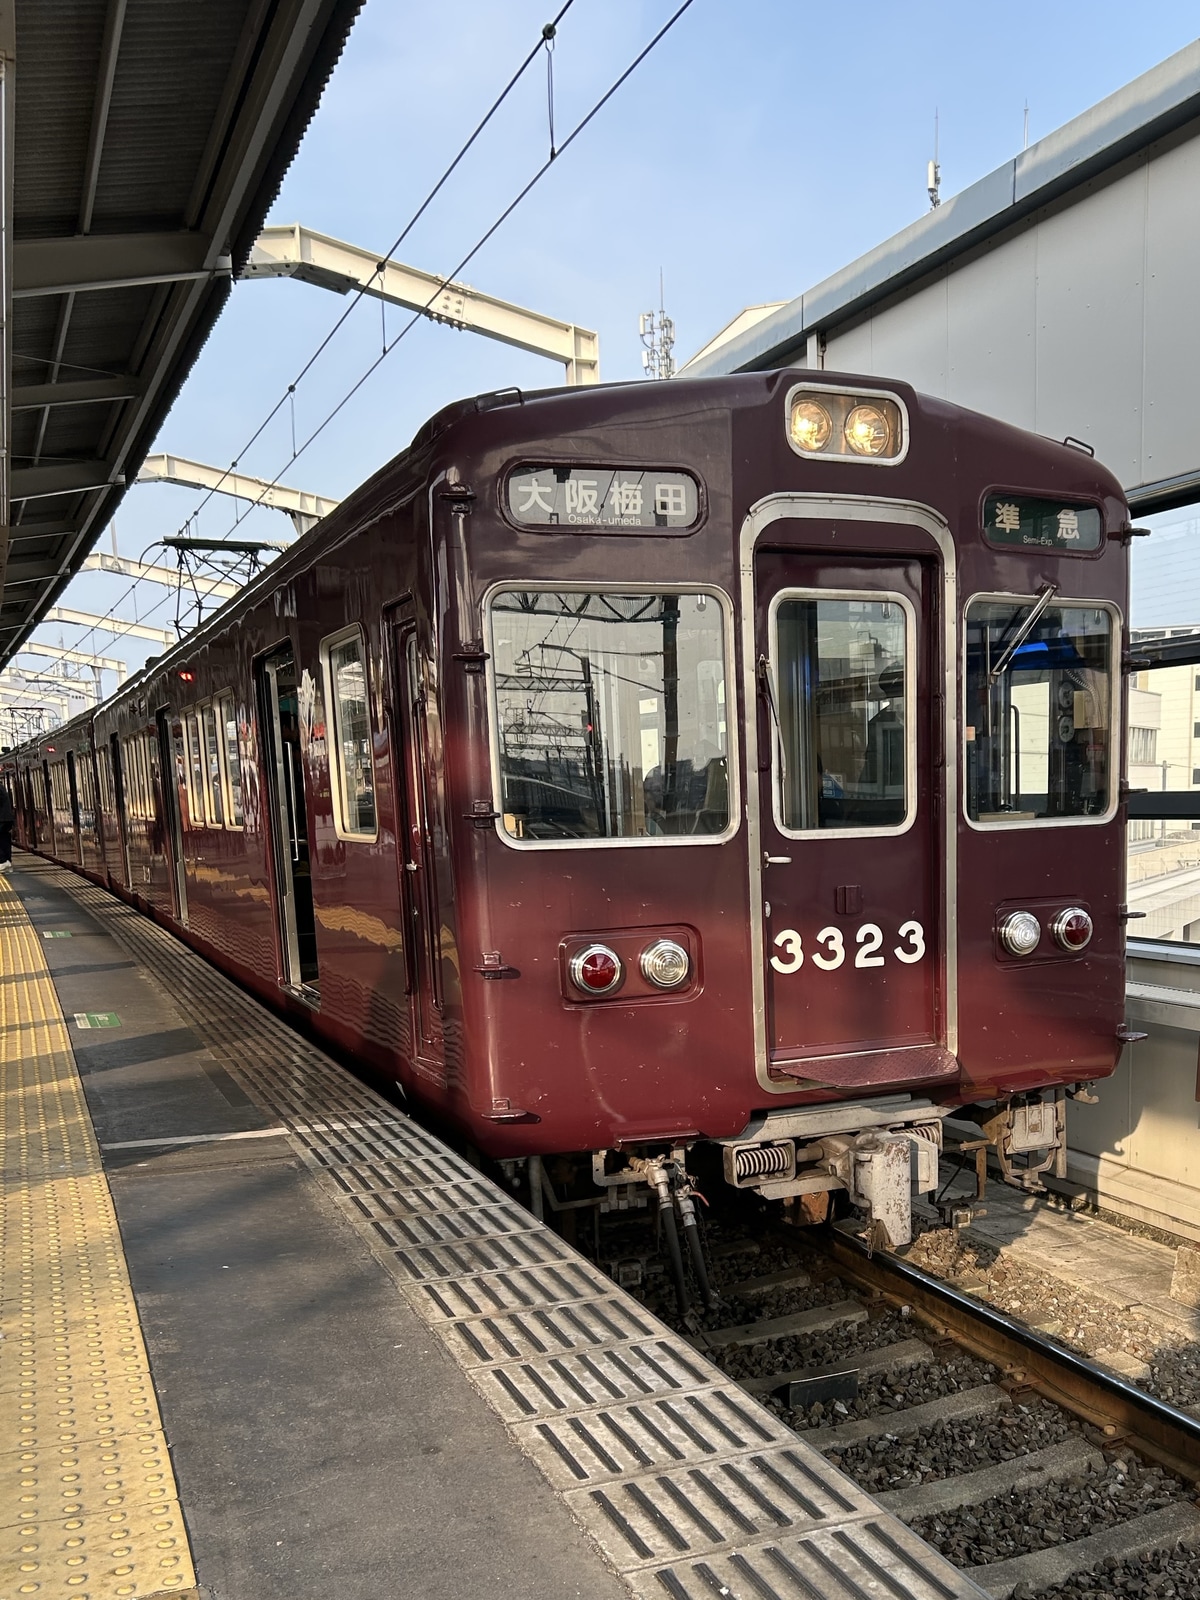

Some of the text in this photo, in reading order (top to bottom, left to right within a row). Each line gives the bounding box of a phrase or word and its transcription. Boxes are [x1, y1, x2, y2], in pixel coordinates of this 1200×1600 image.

[518, 478, 687, 516] 大阪梅田
[568, 514, 641, 526] Osaka-umeda
[995, 502, 1080, 540] 準急
[770, 920, 926, 974] 3323
